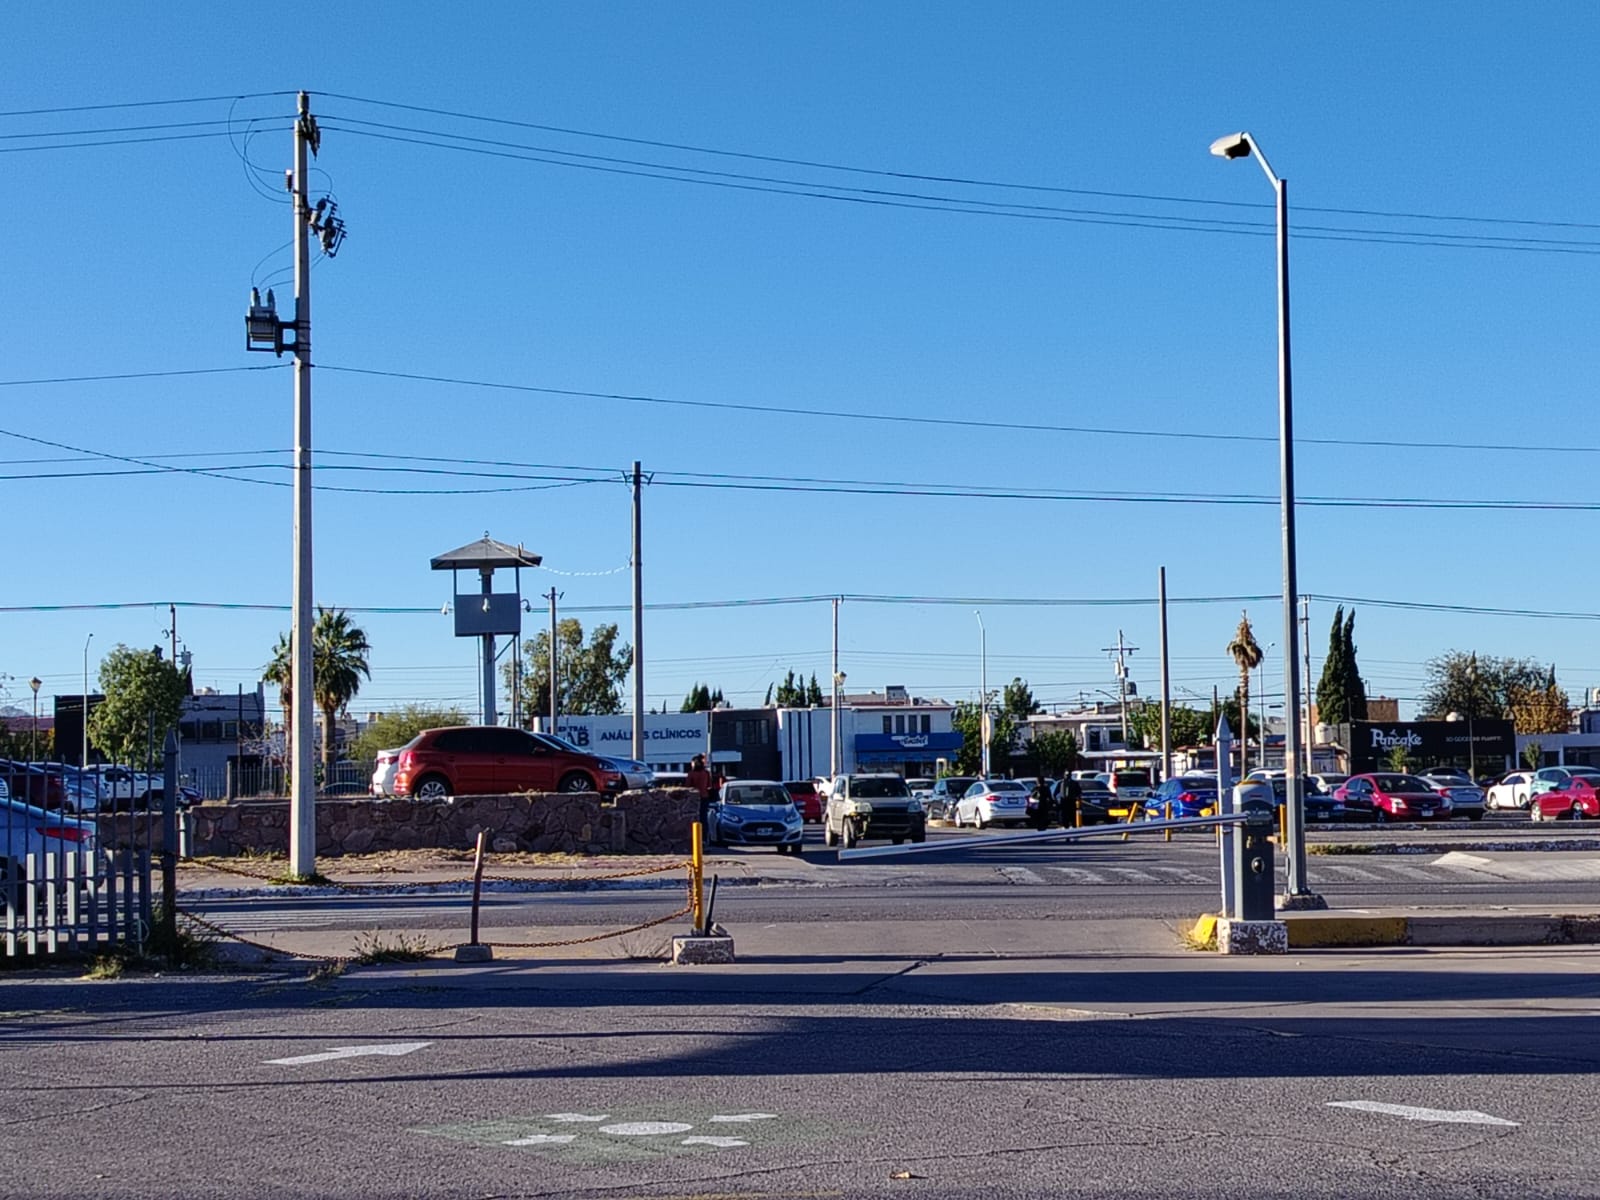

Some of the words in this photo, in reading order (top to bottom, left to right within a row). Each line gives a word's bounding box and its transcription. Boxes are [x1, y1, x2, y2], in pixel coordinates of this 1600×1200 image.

[600, 729, 649, 741] ANÁLIS
[652, 728, 702, 740] CLÍNICOS
[1370, 728, 1422, 747] Pancake
